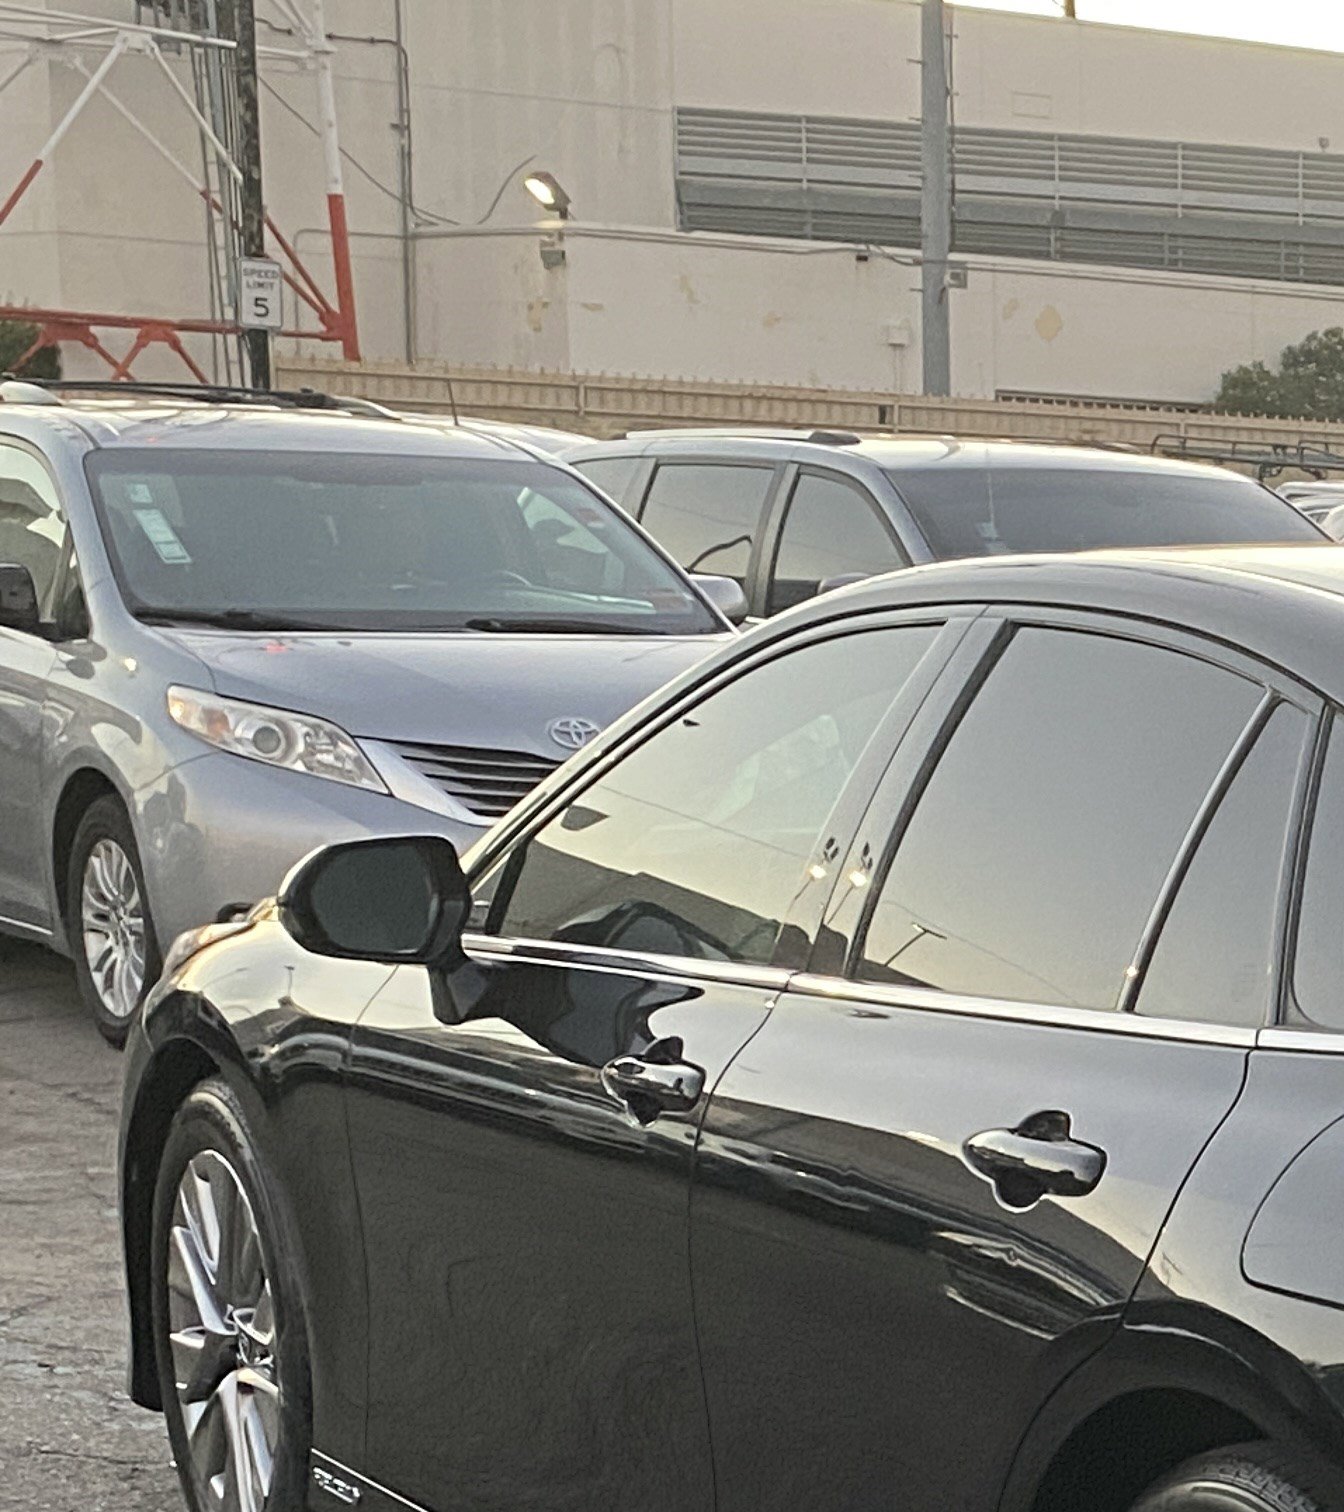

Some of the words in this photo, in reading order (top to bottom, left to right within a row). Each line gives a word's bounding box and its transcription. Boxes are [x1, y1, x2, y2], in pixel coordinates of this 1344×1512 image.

[243, 268, 279, 279] SPEED
[246, 281, 275, 291] LIMIT
[253, 296, 270, 318] 5
